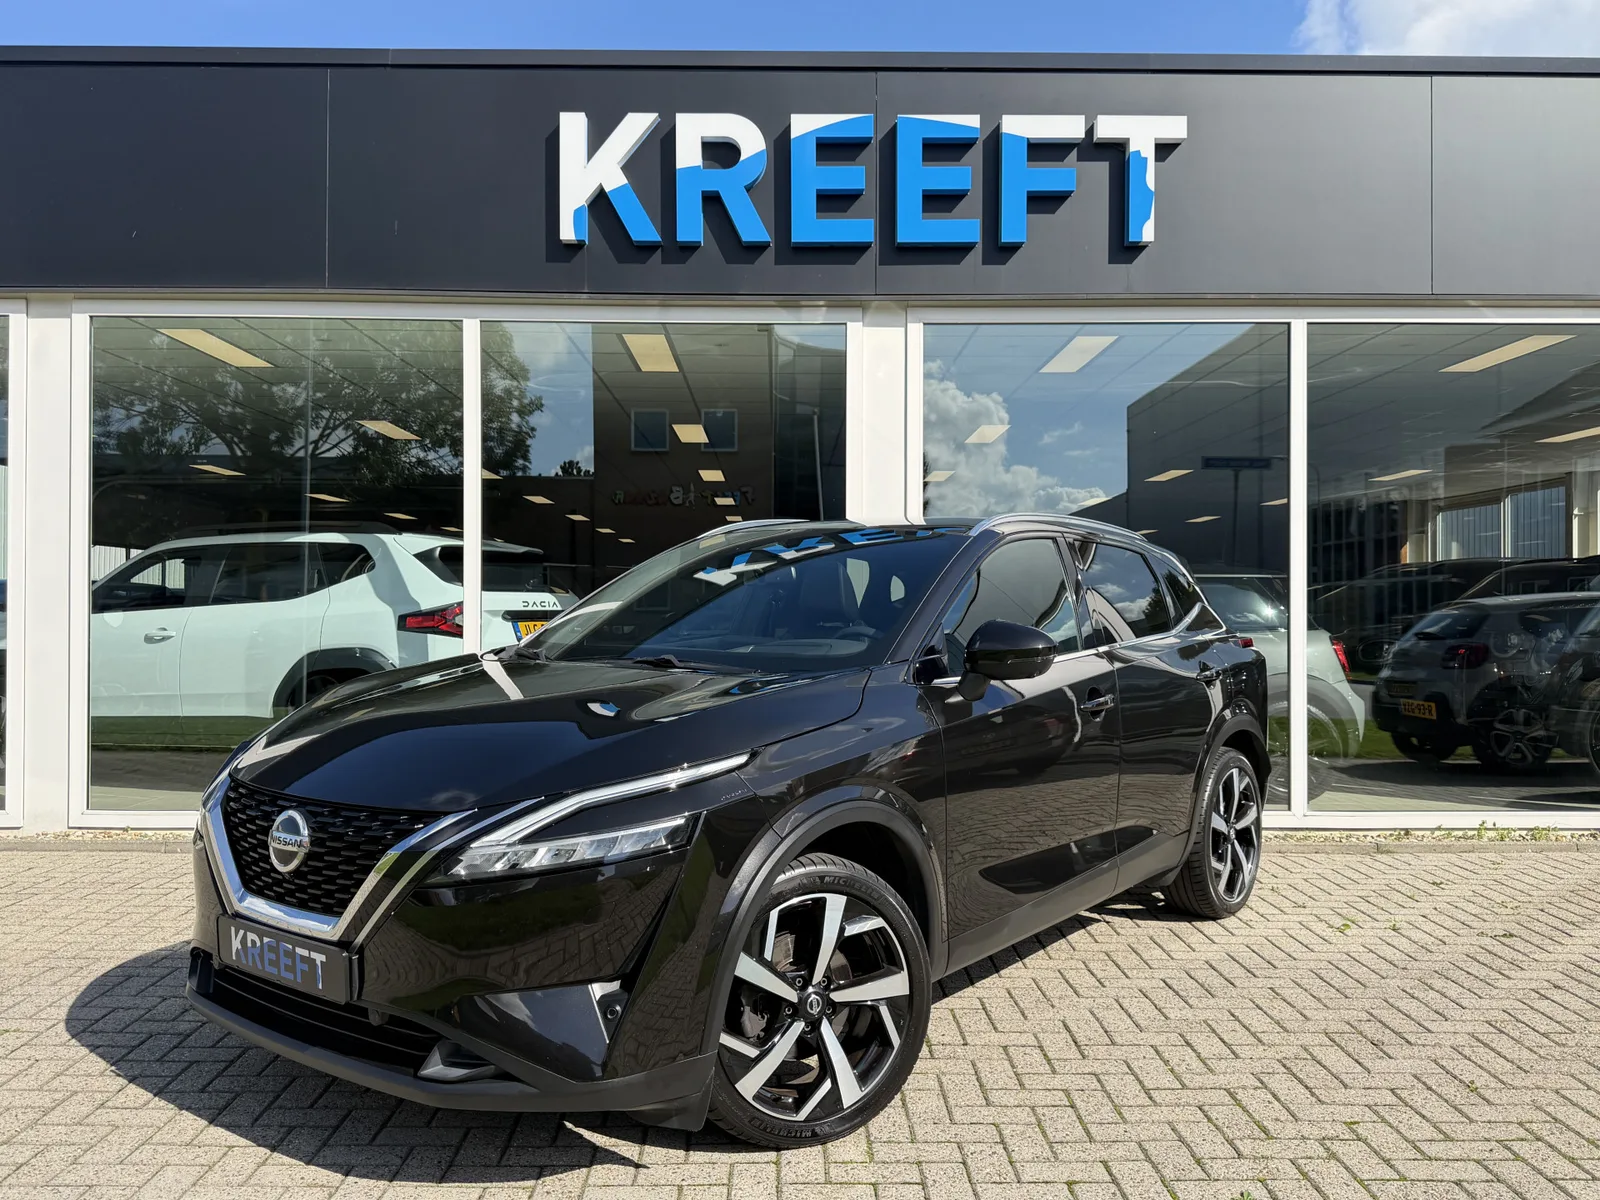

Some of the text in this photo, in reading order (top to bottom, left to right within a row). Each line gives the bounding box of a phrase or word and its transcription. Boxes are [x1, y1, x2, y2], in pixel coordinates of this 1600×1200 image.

[559, 112, 1188, 246] KREEFT
[522, 600, 559, 608] DACIA
[272, 834, 302, 849] NISSAN
[824, 876, 880, 899] MICHELIN
[231, 926, 327, 990] KREEFT
